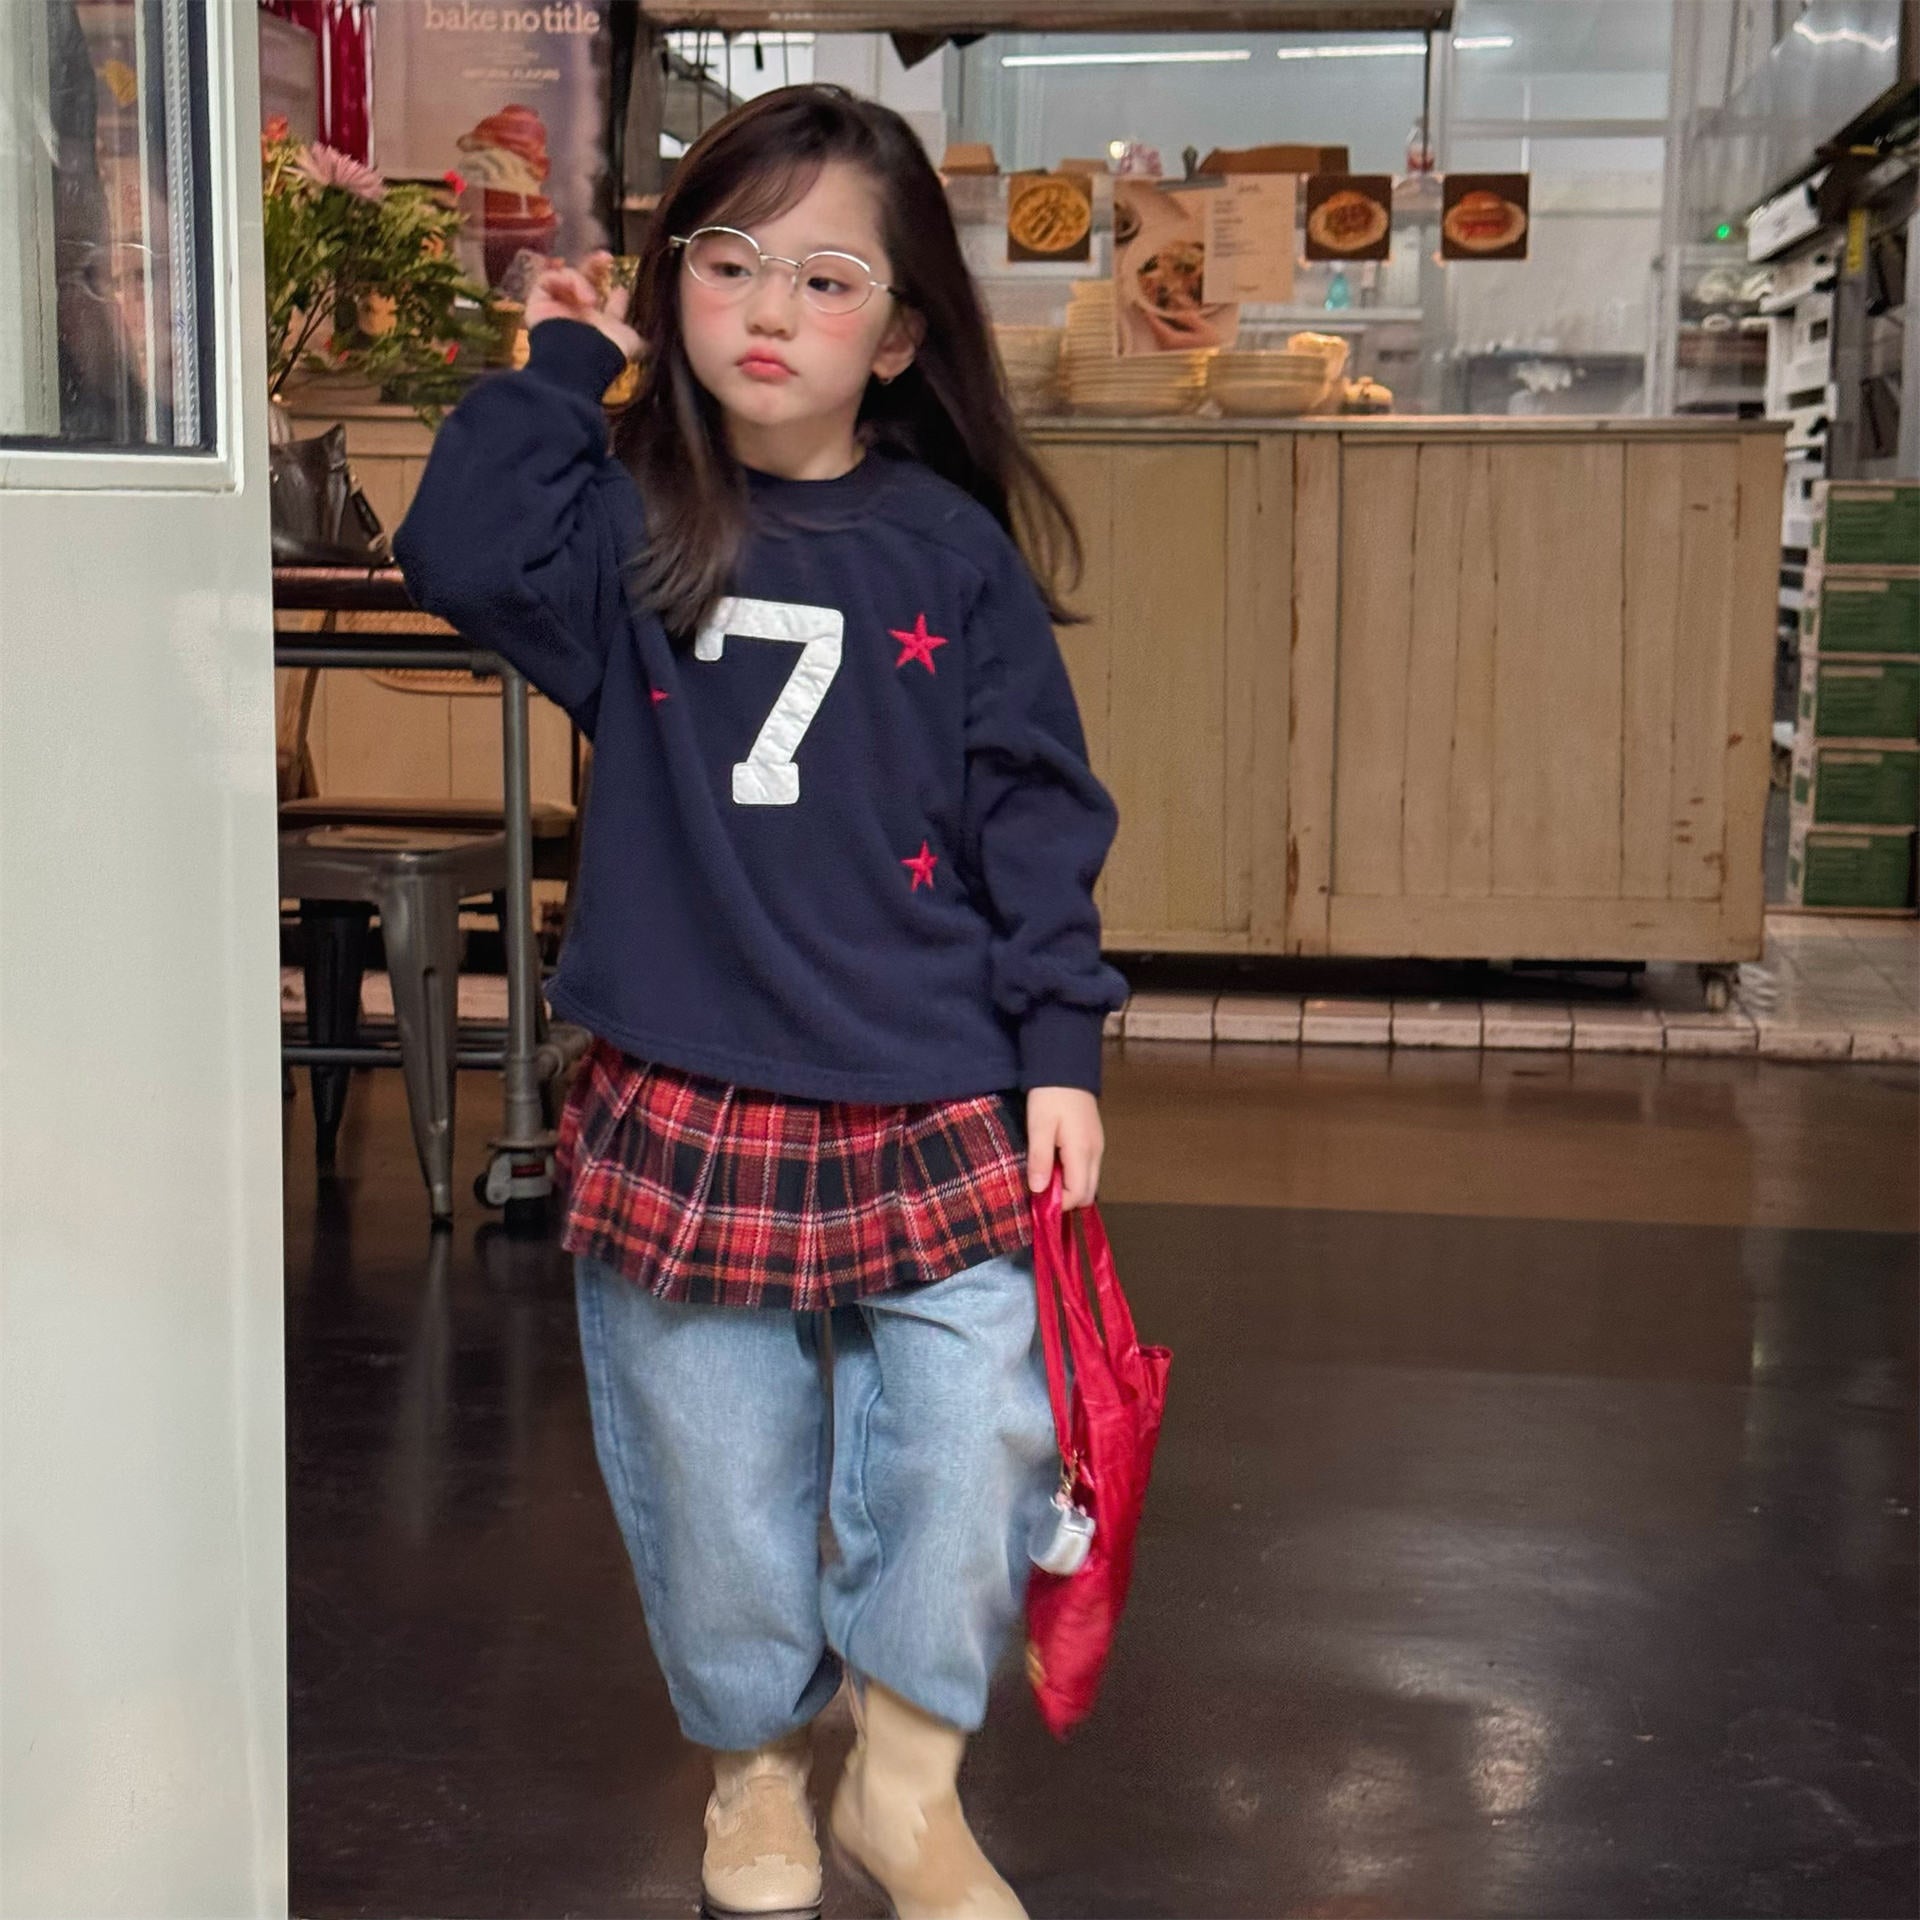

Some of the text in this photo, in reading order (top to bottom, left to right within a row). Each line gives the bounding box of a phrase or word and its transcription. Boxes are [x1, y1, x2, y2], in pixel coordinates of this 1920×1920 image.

[424, 0, 601, 34] bake no title
[694, 596, 845, 805] 7
